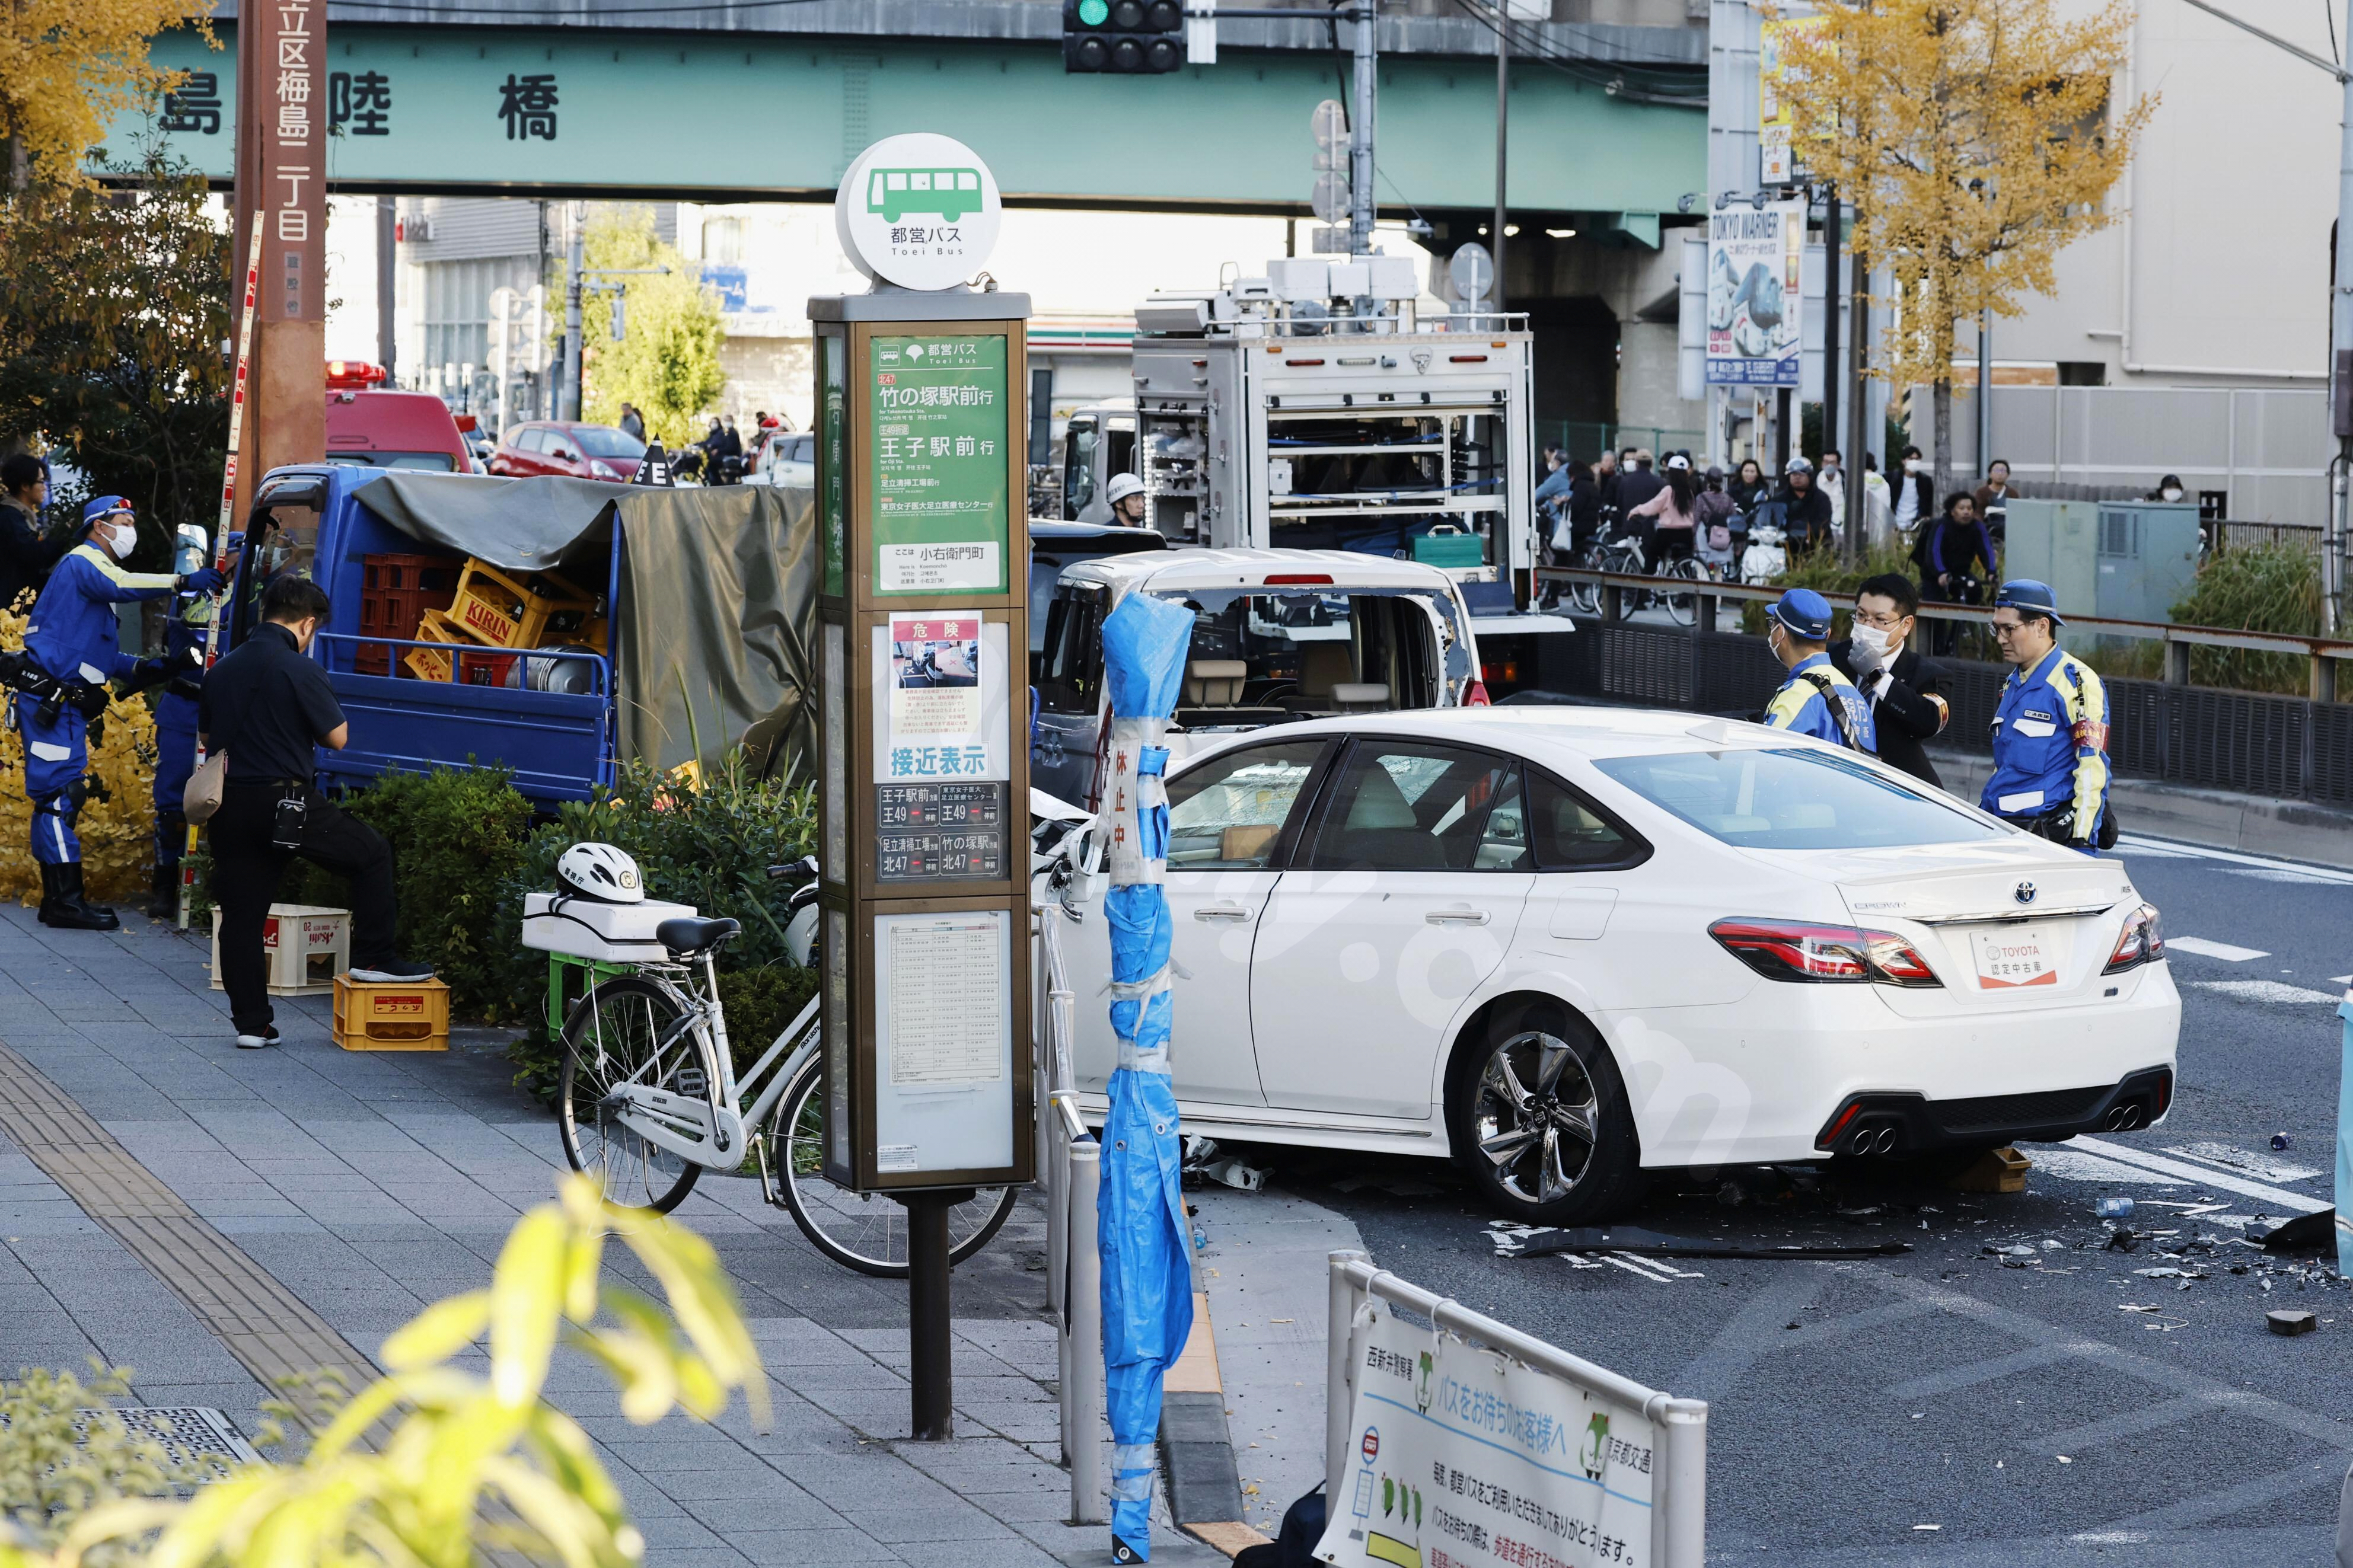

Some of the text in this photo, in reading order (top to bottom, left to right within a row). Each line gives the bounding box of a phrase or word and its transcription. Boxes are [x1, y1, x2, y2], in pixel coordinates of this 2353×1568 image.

[276, 0, 311, 241] 立区梅島二丁目
[1713, 212, 1778, 239] TOKYO WARNER
[891, 226, 962, 244] 都営バス
[891, 247, 962, 256] Toei Bus
[928, 344, 977, 356] 都営バス
[879, 375, 894, 384] 北47
[879, 385, 994, 408] 竹の塚駅前行
[880, 435, 994, 458] 王子駅前行
[652, 463, 667, 484] E
[881, 478, 940, 487] 足立清掃工場前行
[920, 547, 984, 561] 小右衛門町
[466, 599, 511, 639] KIRIN
[913, 622, 959, 638] 危険
[891, 746, 986, 777] 接近表示
[942, 785, 981, 794] 東京女子医大
[1114, 750, 1127, 849] 休止中
[882, 806, 907, 823] 王49
[942, 804, 966, 821] 王49
[884, 856, 908, 873] 北47
[942, 854, 966, 870] 北47
[309, 931, 333, 945] Asahi
[2001, 946, 2040, 958] TOYOTA
[1991, 962, 2042, 976] 認定中古車
[1437, 1372, 1567, 1456] バスをお待ちのお客様へ
